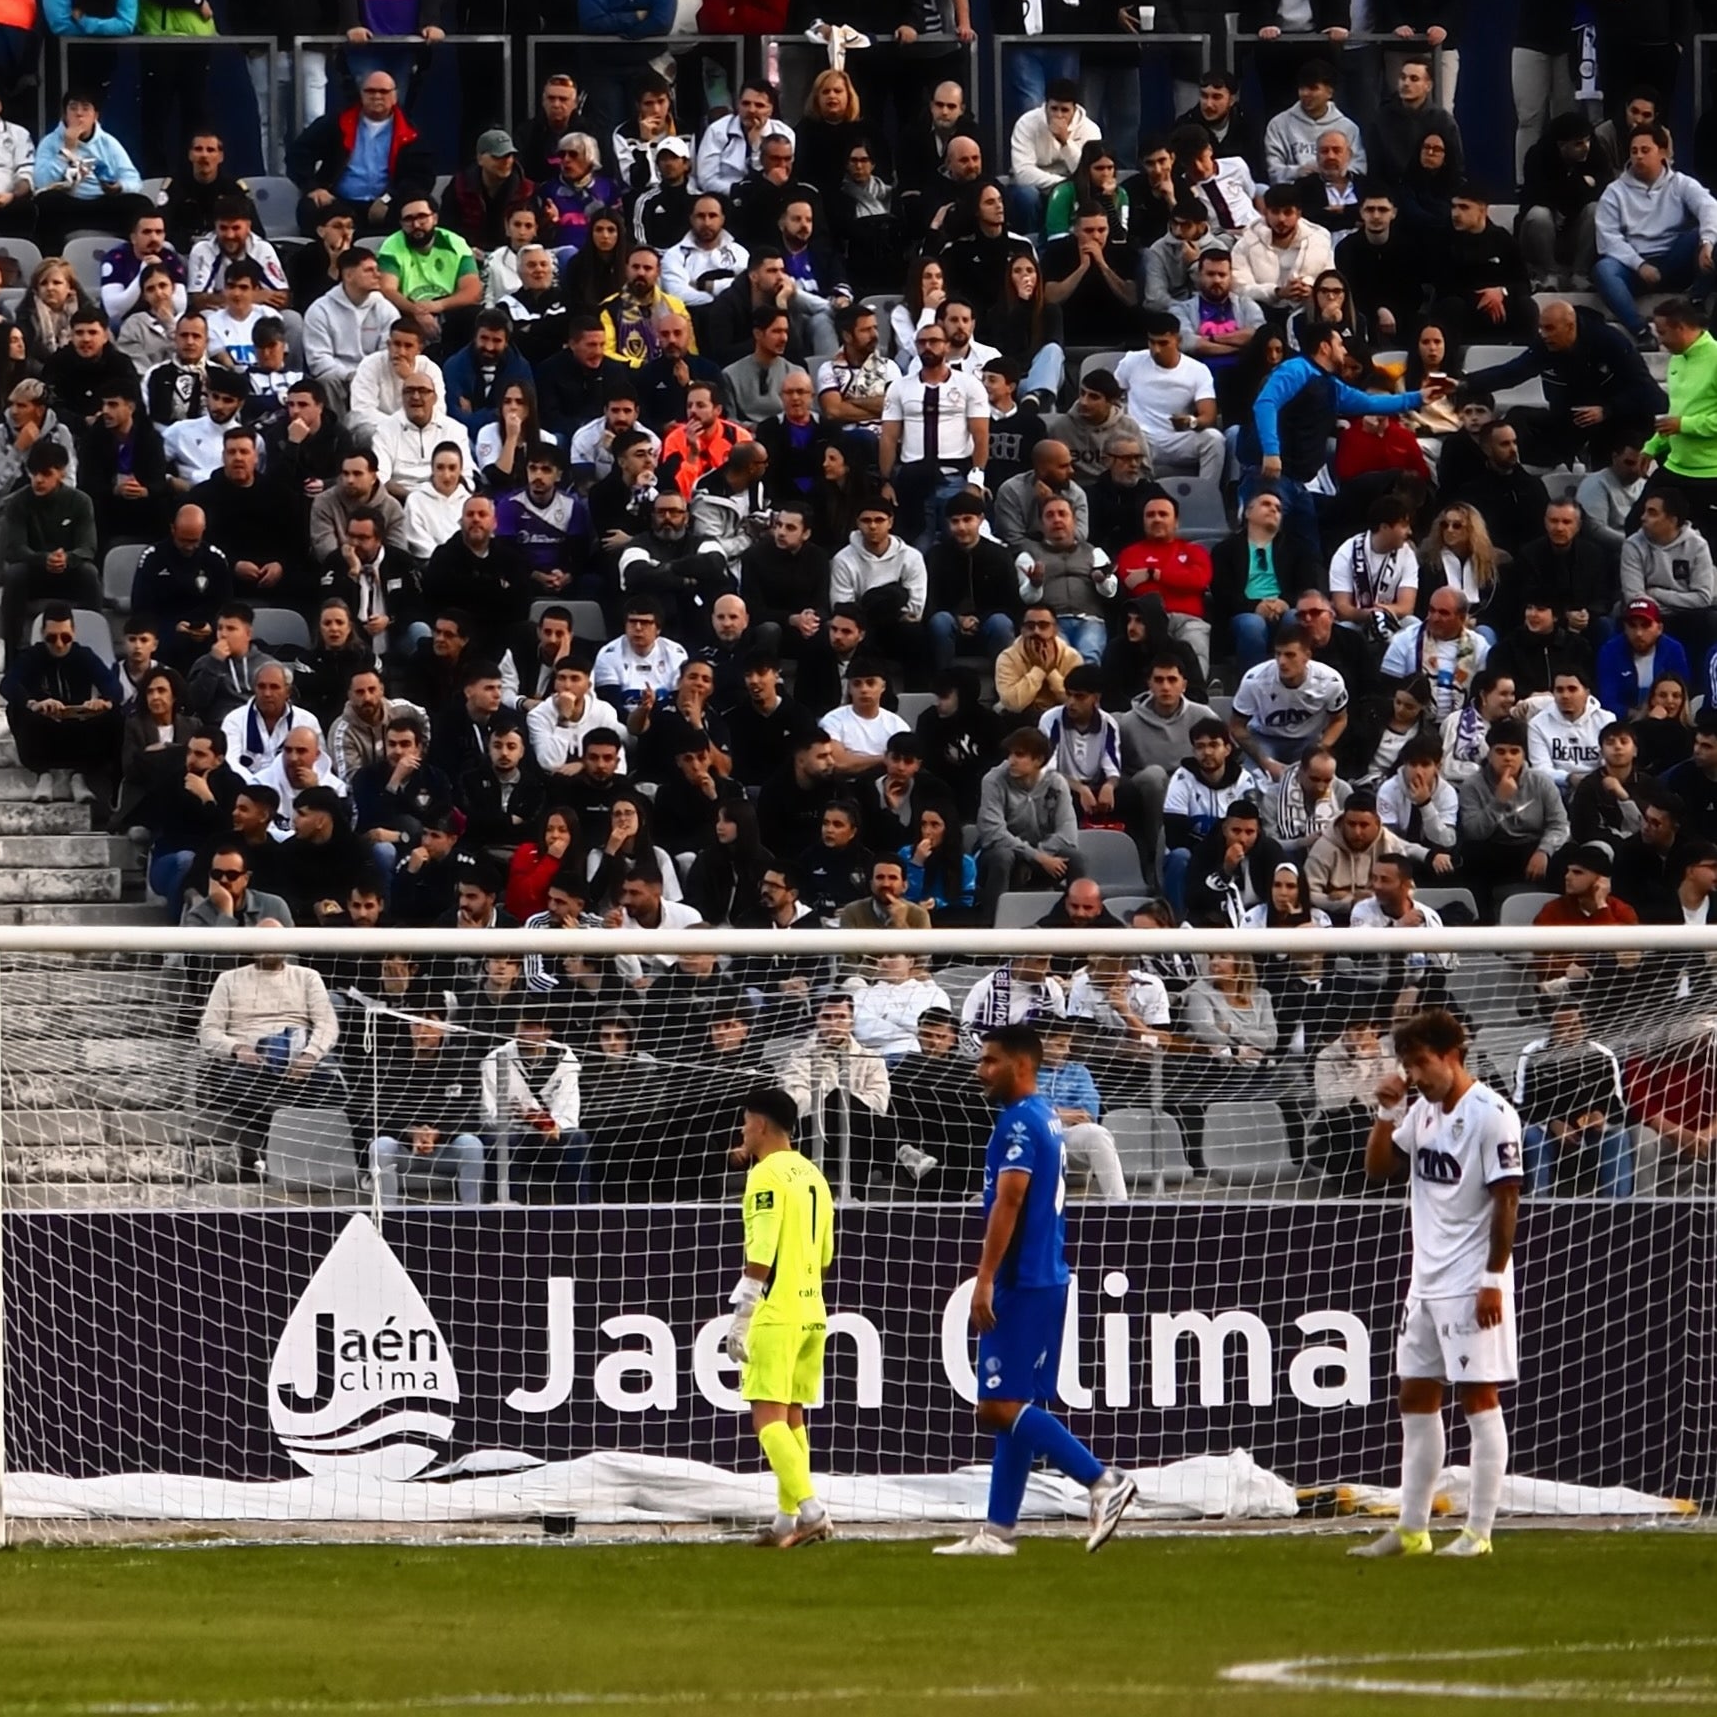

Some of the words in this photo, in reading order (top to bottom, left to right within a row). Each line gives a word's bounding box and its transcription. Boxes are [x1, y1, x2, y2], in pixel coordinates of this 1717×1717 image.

[1552, 737, 1600, 765] BEATLES
[278, 1312, 440, 1415] Jaén
[339, 1366, 439, 1393] clima
